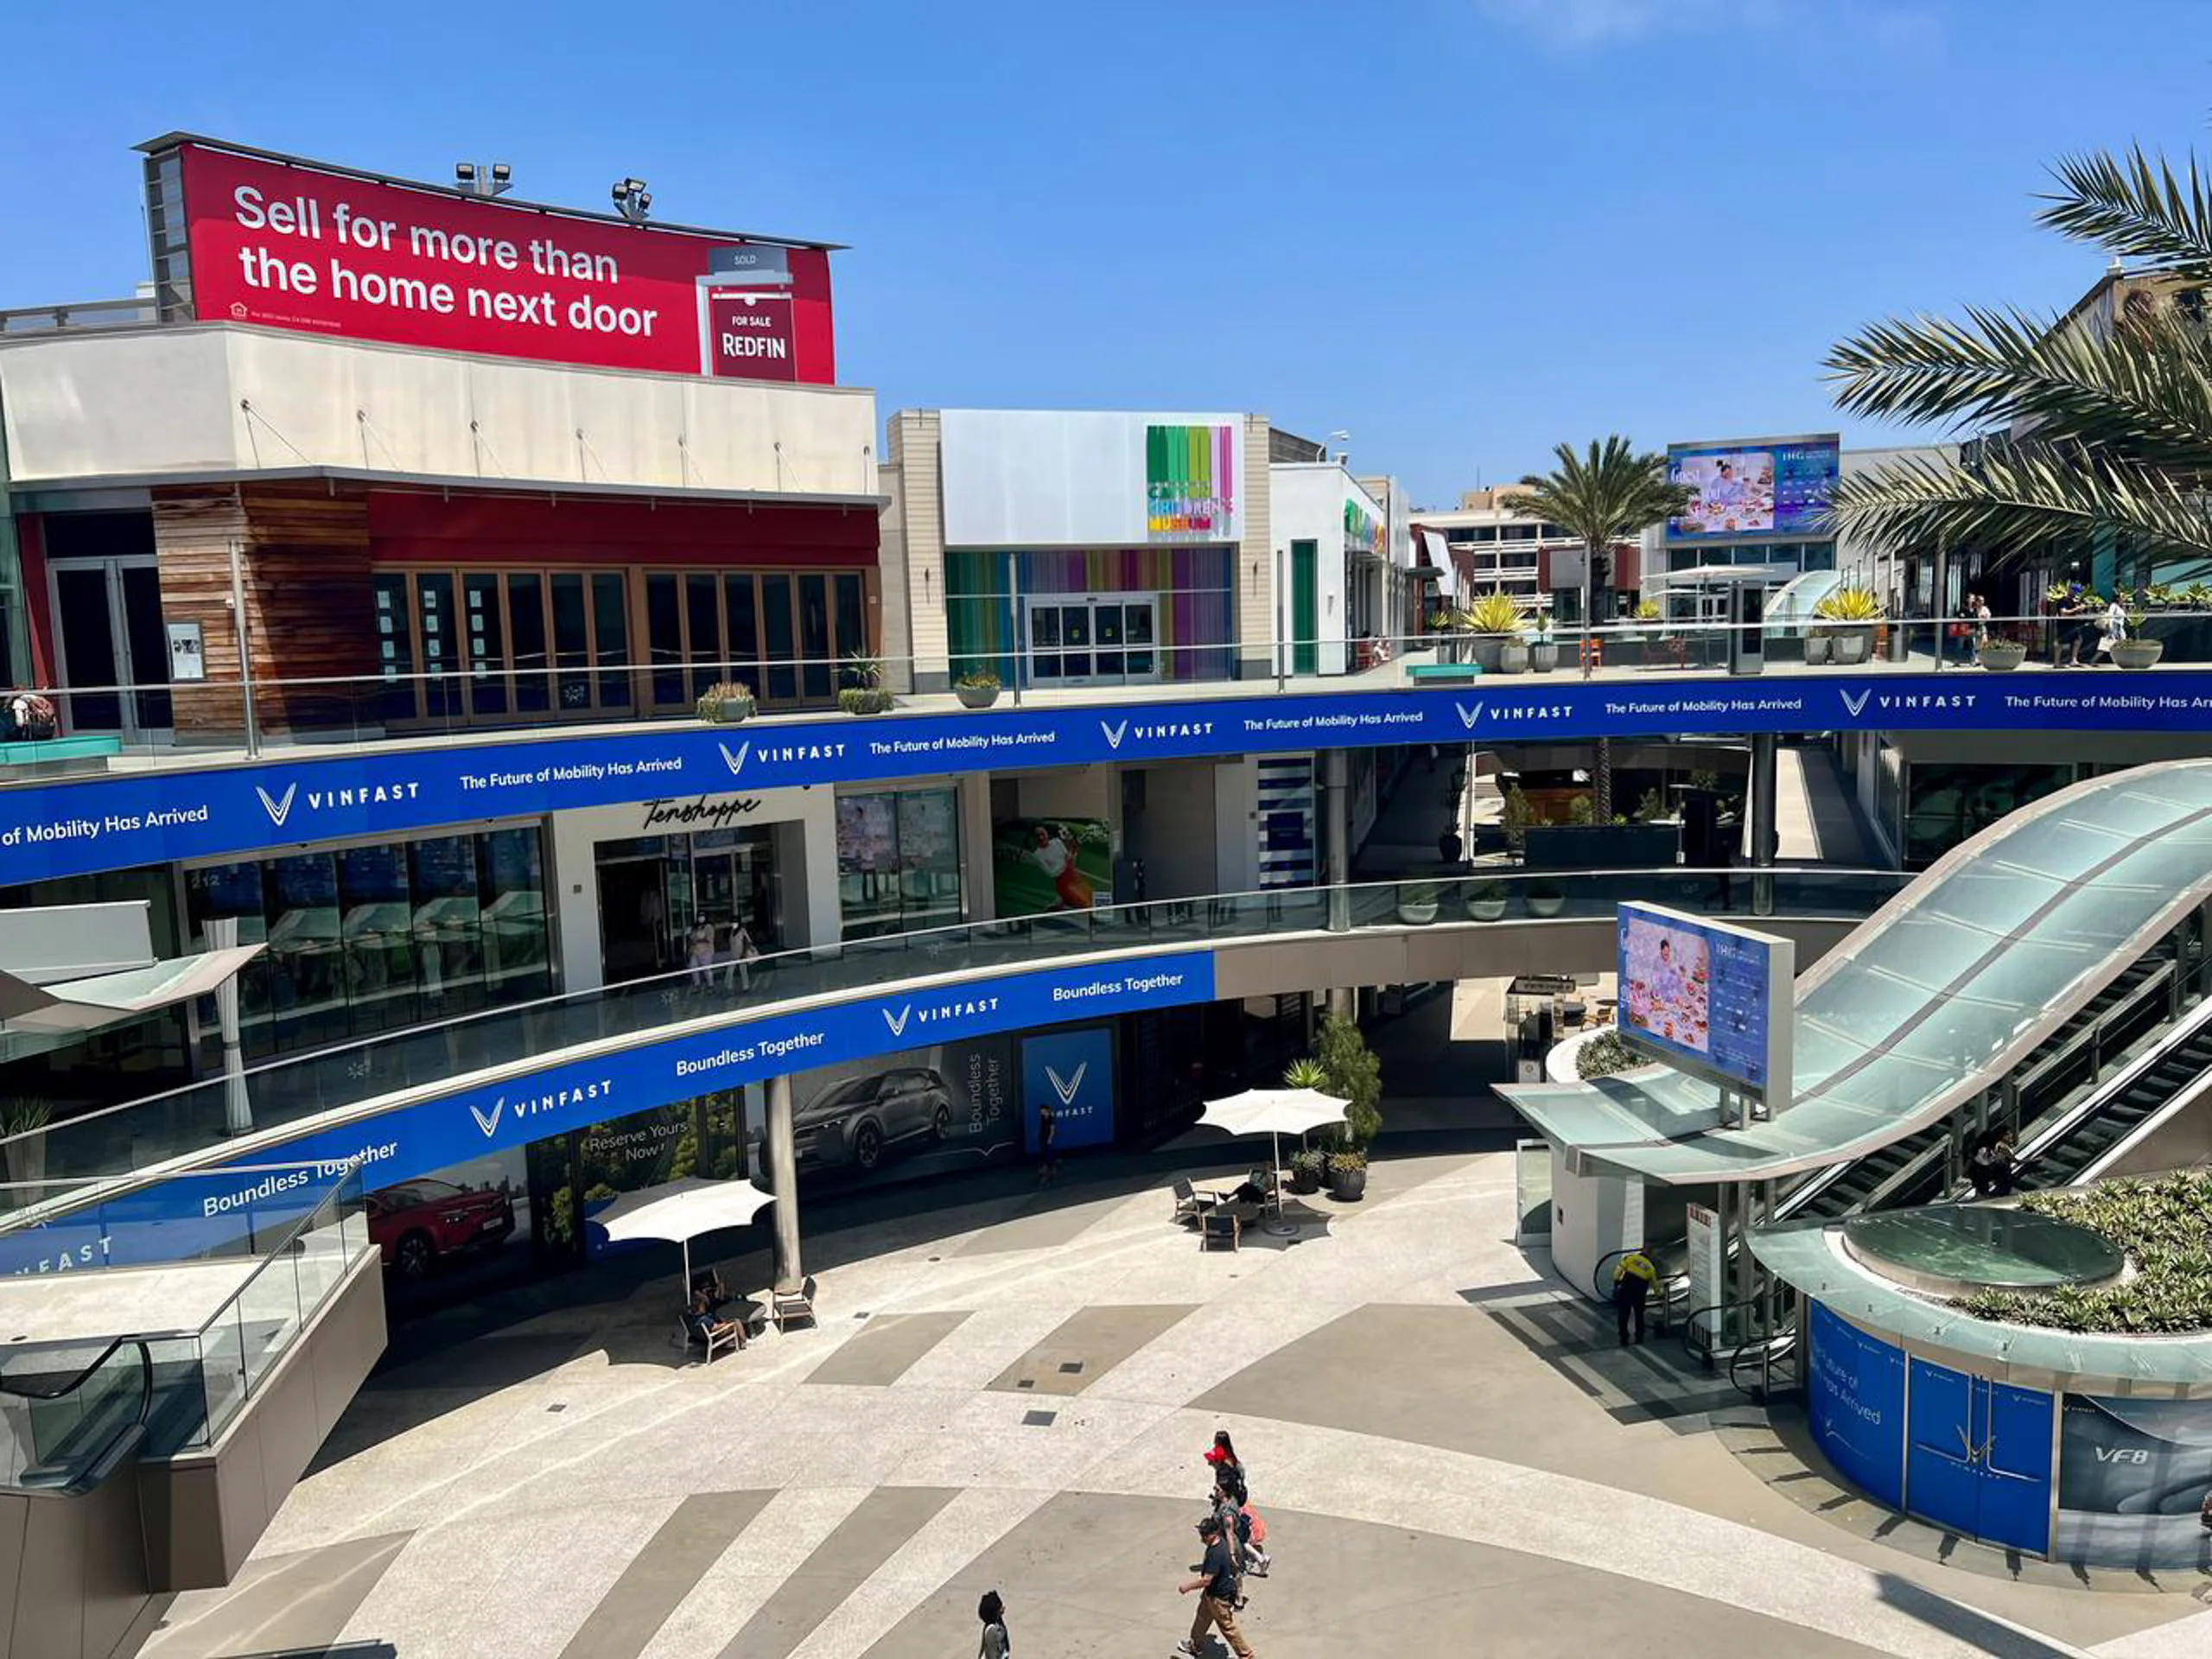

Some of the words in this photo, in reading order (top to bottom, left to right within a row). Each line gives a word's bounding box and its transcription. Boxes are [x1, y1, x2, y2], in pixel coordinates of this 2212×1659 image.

[234, 186, 321, 239] Sell
[333, 203, 397, 251] for
[410, 226, 518, 270] more
[529, 239, 618, 284] than
[734, 254, 757, 265] SOLD
[238, 246, 317, 295] the
[331, 258, 455, 315] home
[467, 288, 557, 327] next
[568, 295, 658, 336] door
[732, 315, 748, 326] FOR
[749, 315, 772, 327] SALE
[1491, 706, 1573, 720] VINFAST
[1605, 702, 1627, 714] The
[1629, 702, 1666, 713] Future
[1668, 701, 1680, 712] of
[1682, 700, 1729, 713] Mobility
[1731, 700, 1755, 710] Has
[1758, 698, 1802, 709] Arrived
[1879, 695, 1976, 708] VINFAST
[2005, 696, 2031, 708] The
[2033, 696, 2078, 708] Future
[2081, 696, 2096, 708] of
[2099, 696, 2156, 710] Mobility
[2159, 696, 2188, 708] Has
[1135, 722, 1212, 739] VINFAST
[1243, 720, 1264, 731] The
[1266, 718, 1300, 730] Future
[1301, 716, 1313, 728] of
[1315, 715, 1358, 728] Mobility
[1359, 715, 1382, 725] Has
[1383, 711, 1423, 723] Arrived
[758, 744, 844, 763] VINFAST
[869, 742, 892, 754] The
[893, 741, 931, 753] Future
[931, 737, 944, 750] of
[946, 735, 989, 749] Mobility
[991, 734, 1014, 746] Has
[1015, 732, 1055, 744] Arrived
[460, 775, 486, 790] The
[490, 772, 533, 787] Future
[536, 767, 550, 782] of
[553, 764, 605, 780] Mobility
[607, 762, 633, 775] Has
[635, 756, 682, 772] Arrived
[308, 782, 418, 810] VINFAST
[1, 827, 22, 846] of
[26, 819, 100, 842] Mobility
[105, 815, 141, 832] Has
[144, 804, 208, 827] Arrived
[1052, 982, 1122, 1001] Boundless
[1124, 974, 1183, 993] Together
[918, 997, 998, 1022] VINFAST
[677, 1048, 755, 1077] Boundless
[757, 1033, 824, 1057] Together
[513, 1078, 612, 1119] VINFAST
[968, 1052, 982, 1134] Boundless
[985, 1058, 1002, 1126] Together
[589, 1131, 646, 1153] Reserve
[649, 1122, 688, 1138] Yours
[203, 1170, 308, 1217] Boundless
[16, 1236, 111, 1274] FAST
[1840, 1388, 1882, 1426] Arrived
[2094, 1445, 2150, 1465] VF8
